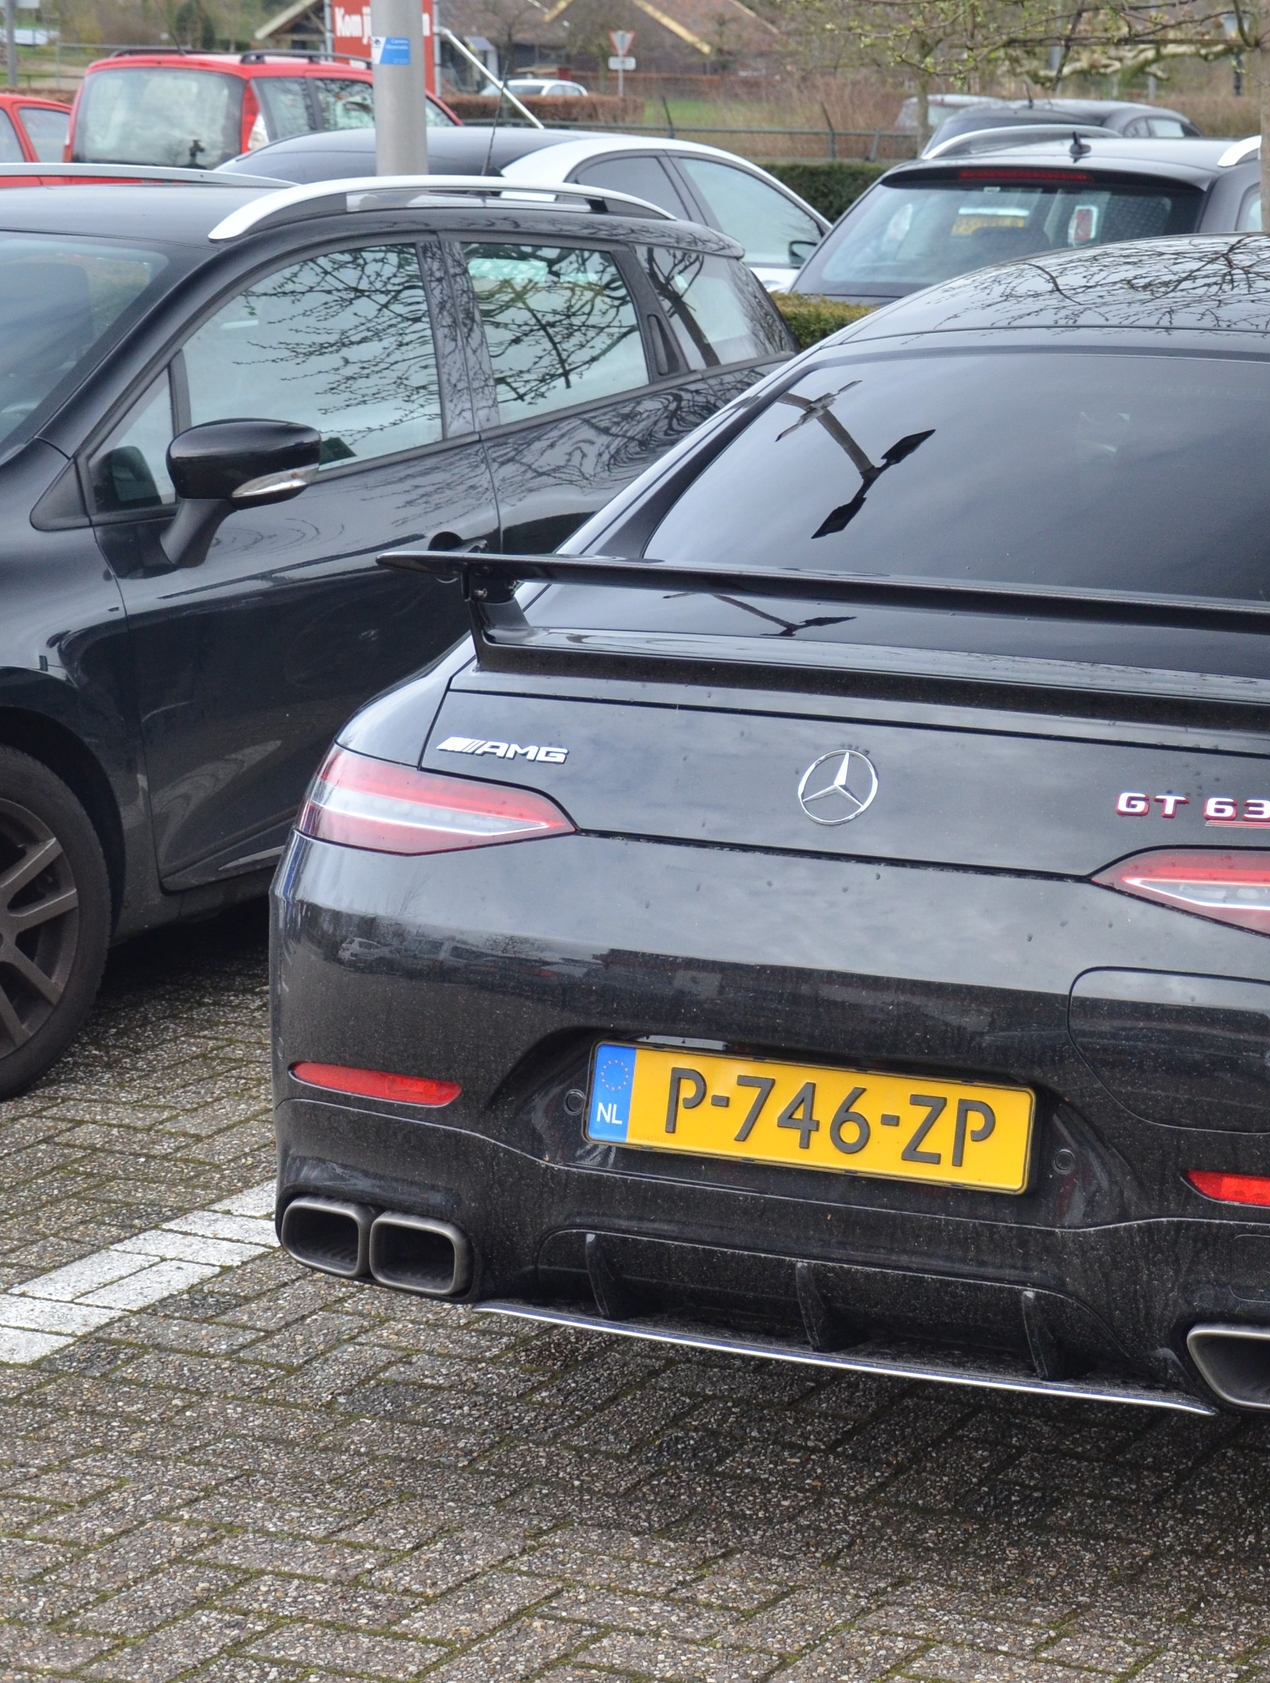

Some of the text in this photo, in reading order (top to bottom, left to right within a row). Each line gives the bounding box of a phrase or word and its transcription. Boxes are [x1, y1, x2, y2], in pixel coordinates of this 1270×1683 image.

[475, 741, 569, 764] AMG
[1116, 791, 1189, 818] GT
[596, 1101, 623, 1125] NL
[664, 1066, 996, 1167] P-746-ZP
